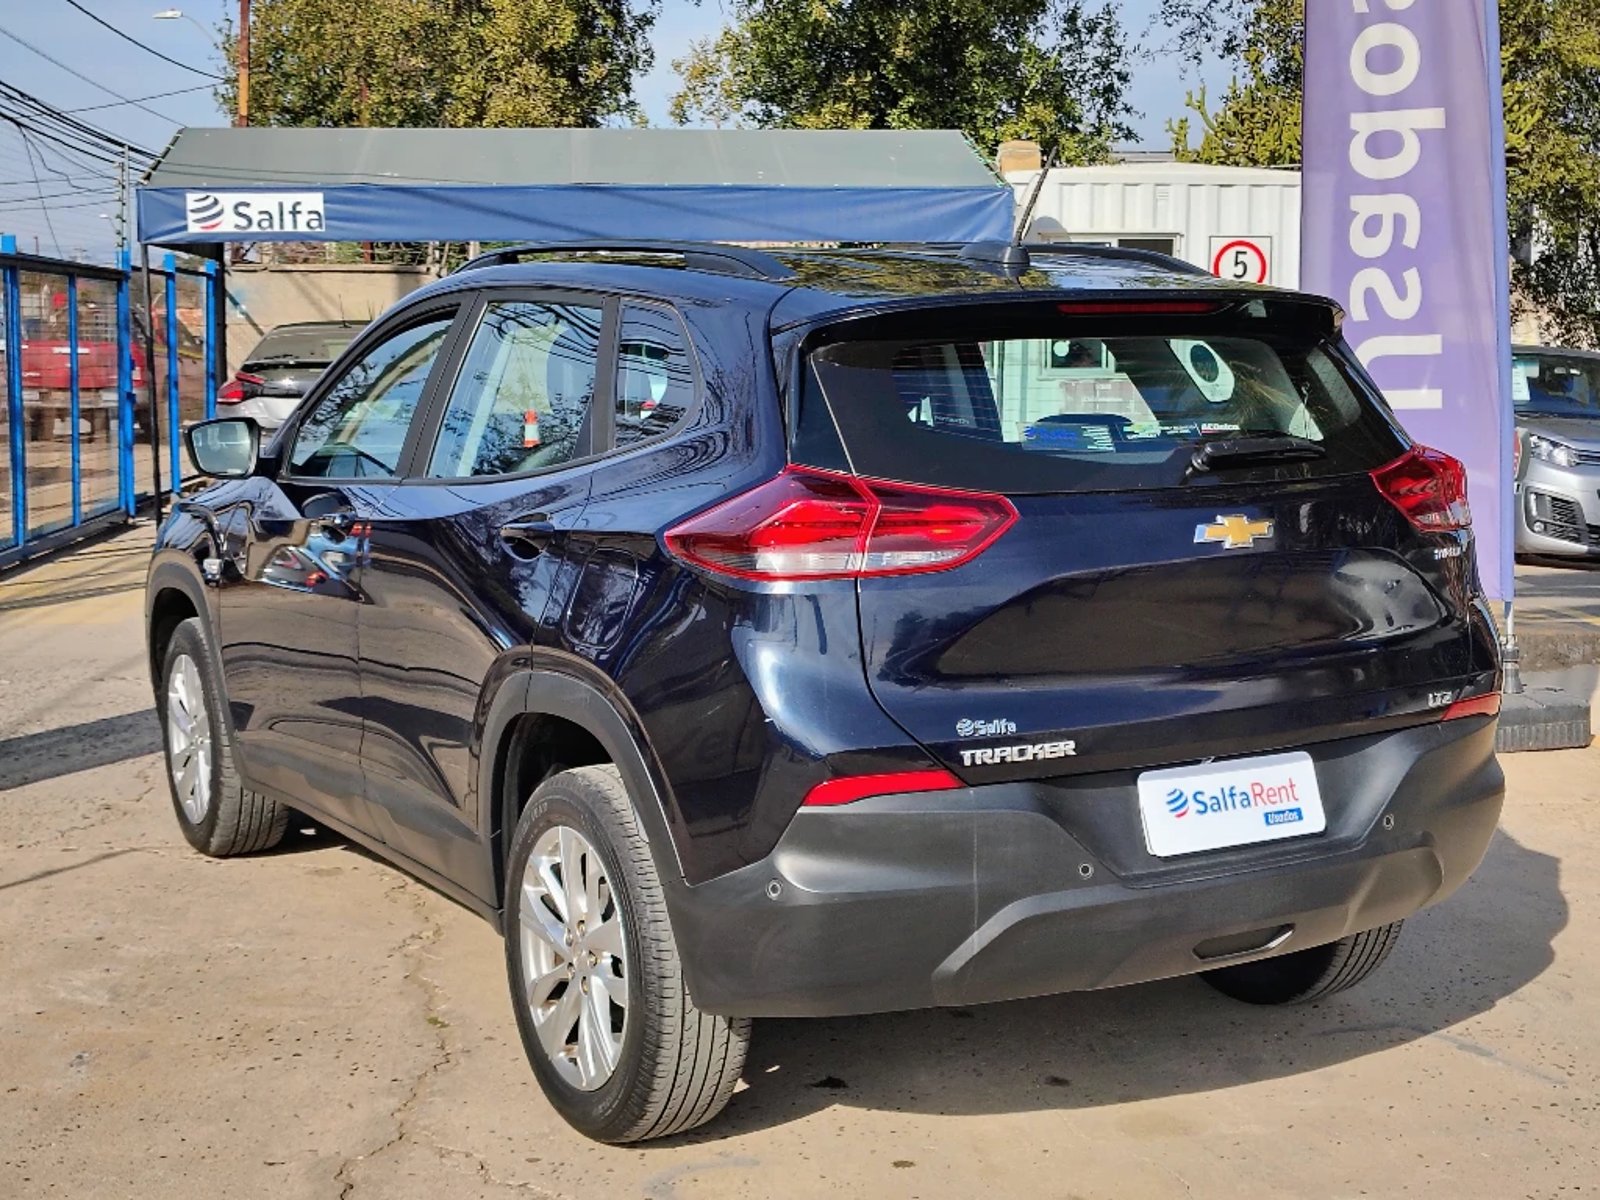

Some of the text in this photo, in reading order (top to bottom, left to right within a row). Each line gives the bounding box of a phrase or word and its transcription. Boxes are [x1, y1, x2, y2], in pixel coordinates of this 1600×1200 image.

[233, 201, 324, 231] Salfa
[1233, 251, 1248, 279] 5
[974, 718, 1017, 737] Salfa
[960, 740, 1077, 767] TRACKER
[1192, 777, 1299, 815] SalfaRent
[1267, 810, 1300, 825] Usados
